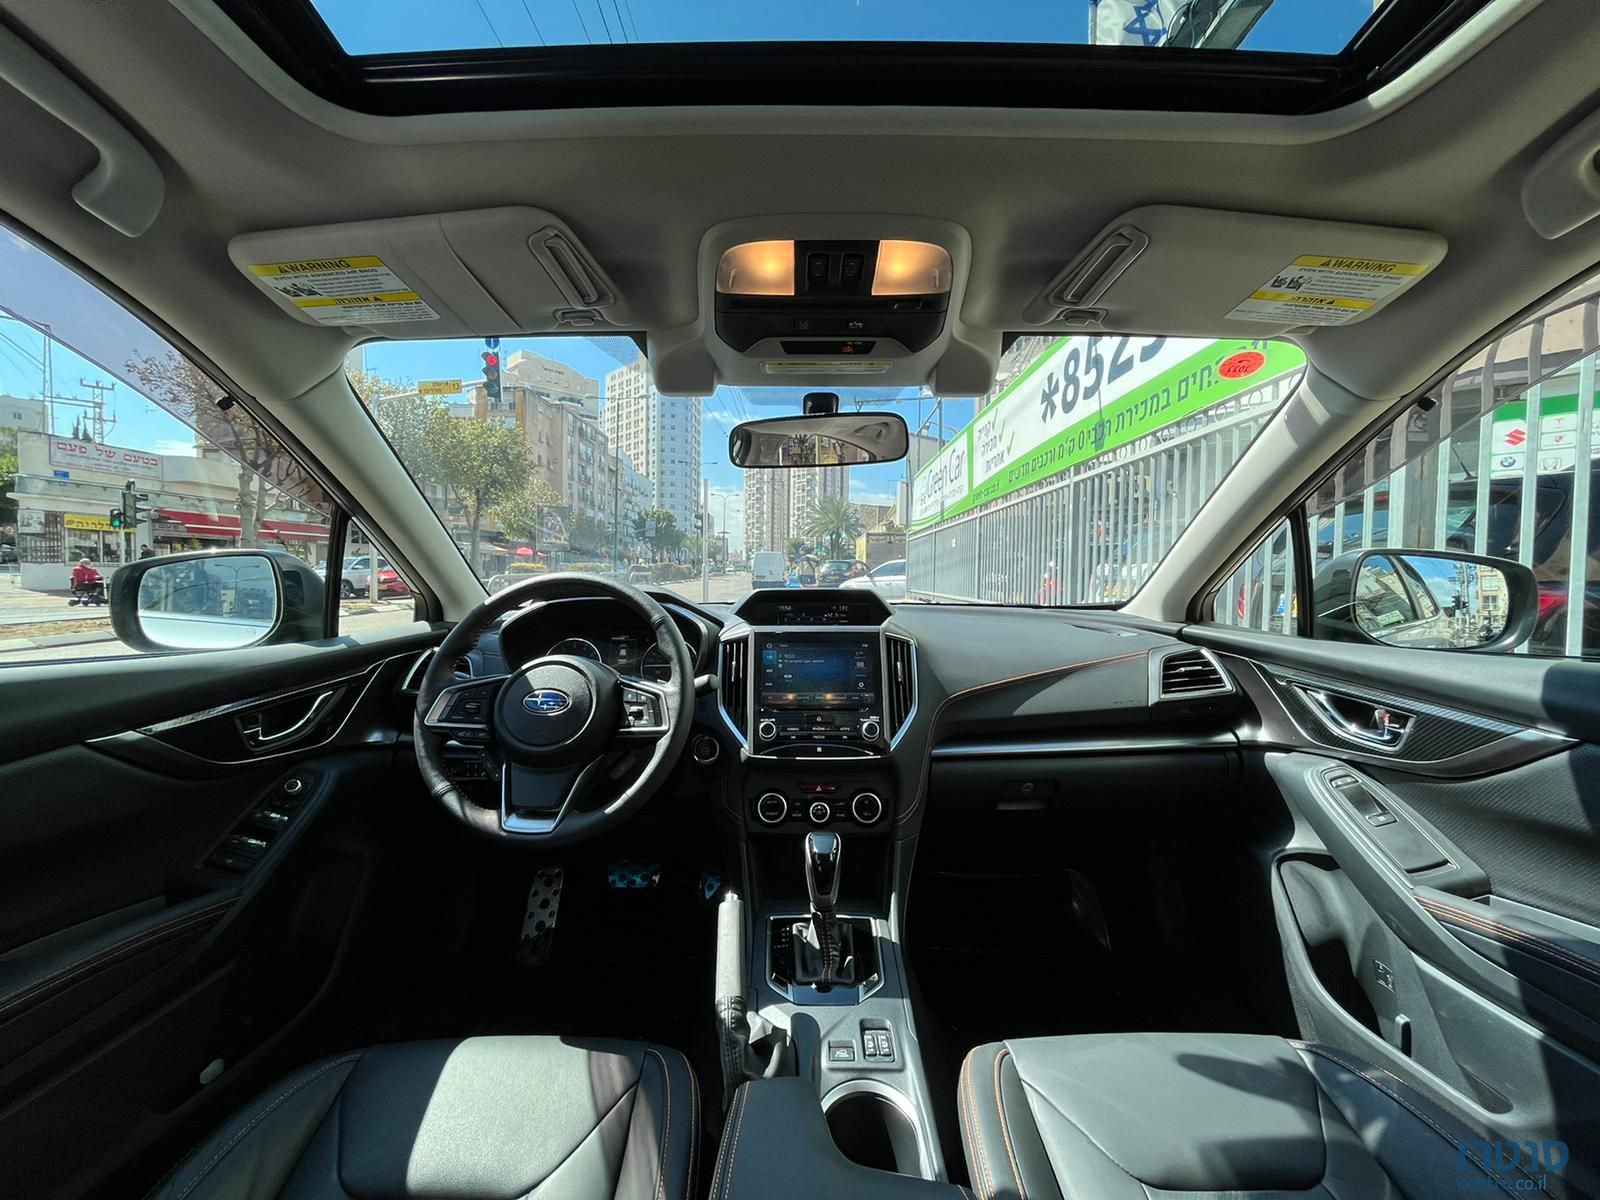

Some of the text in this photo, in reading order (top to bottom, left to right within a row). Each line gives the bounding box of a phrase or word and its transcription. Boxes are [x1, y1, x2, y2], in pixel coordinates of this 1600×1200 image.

[285, 260, 351, 273] WARNING
[1332, 259, 1397, 272] WARNING
[1115, 386, 1172, 433] במכירת
[56, 441, 88, 454] פעם
[95, 445, 116, 458] של
[123, 453, 159, 466] בטעם
[1031, 447, 1056, 472] ורכבים
[927, 449, 965, 498] Green Car
[1008, 461, 1030, 482] חדשים
